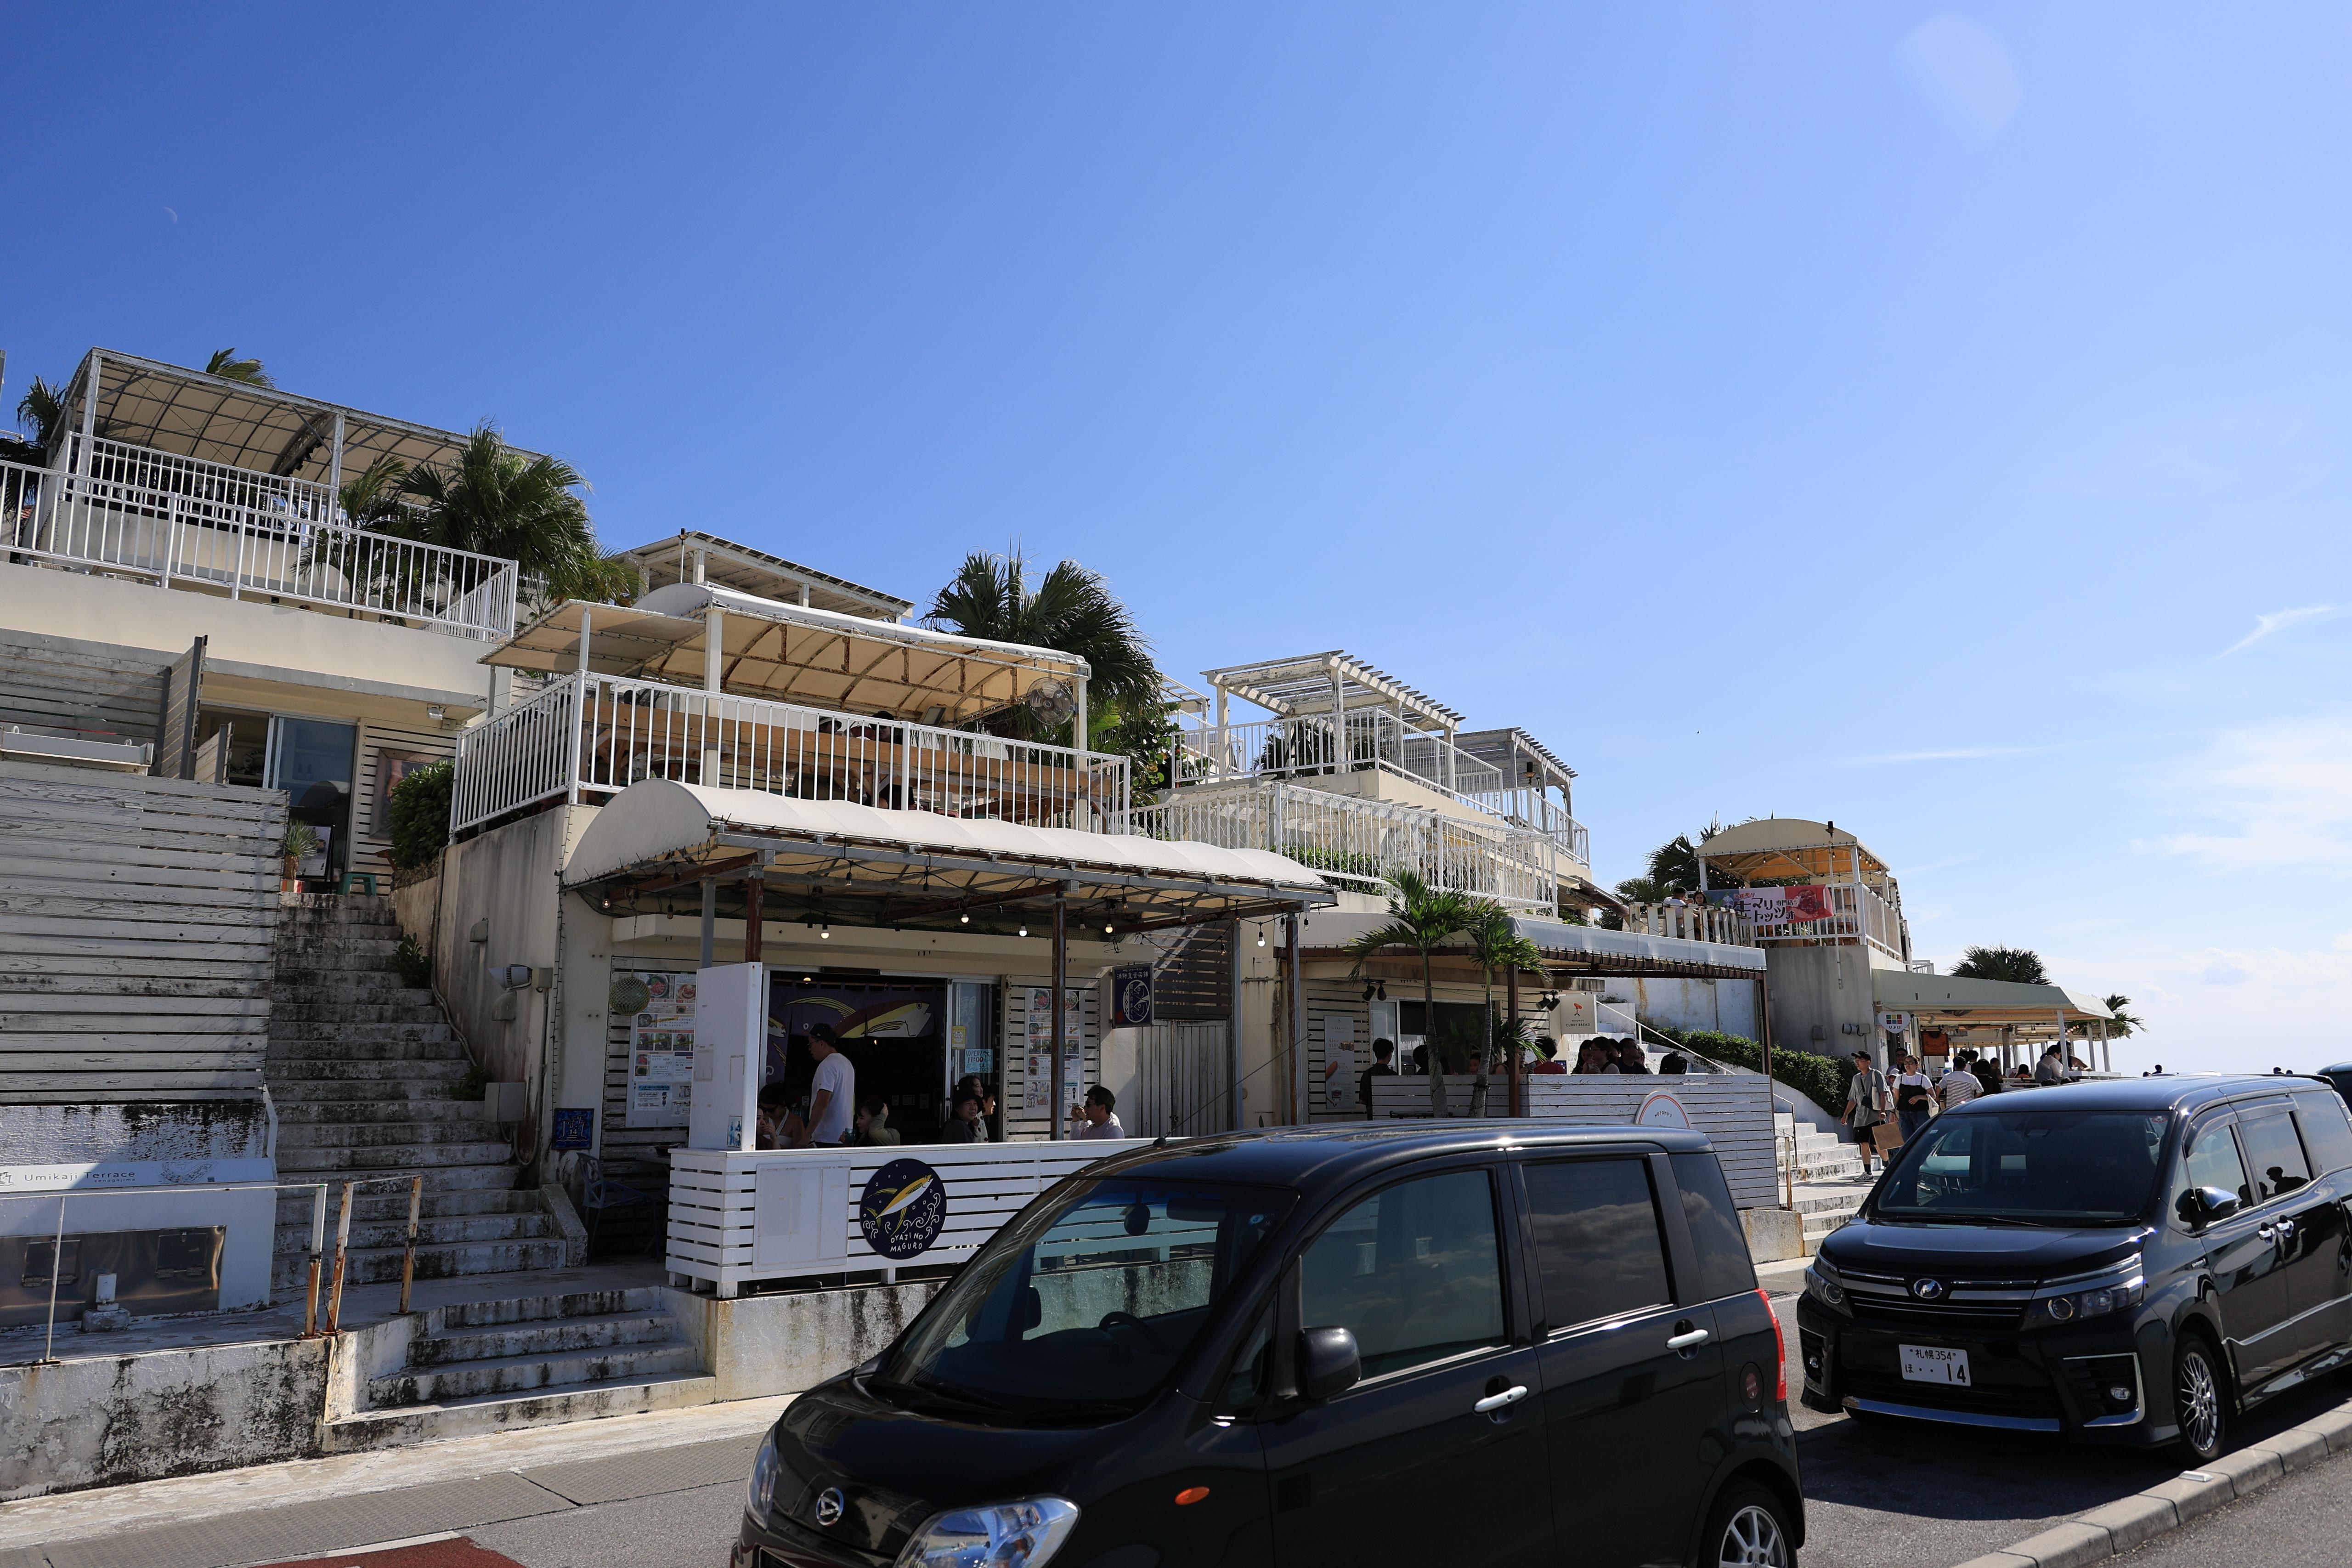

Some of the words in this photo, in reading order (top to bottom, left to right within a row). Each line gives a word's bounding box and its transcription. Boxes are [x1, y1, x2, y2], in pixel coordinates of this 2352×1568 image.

[24, 1173, 78, 1182] Umikaji
[890, 1232, 911, 1243] OYAJI
[890, 1242, 922, 1252] MAGURO
[1915, 1349, 1934, 1359] 札幌
[1935, 1350, 1952, 1361] 354
[1905, 1364, 1914, 1373] ほ
[1947, 1363, 1966, 1383] 14
